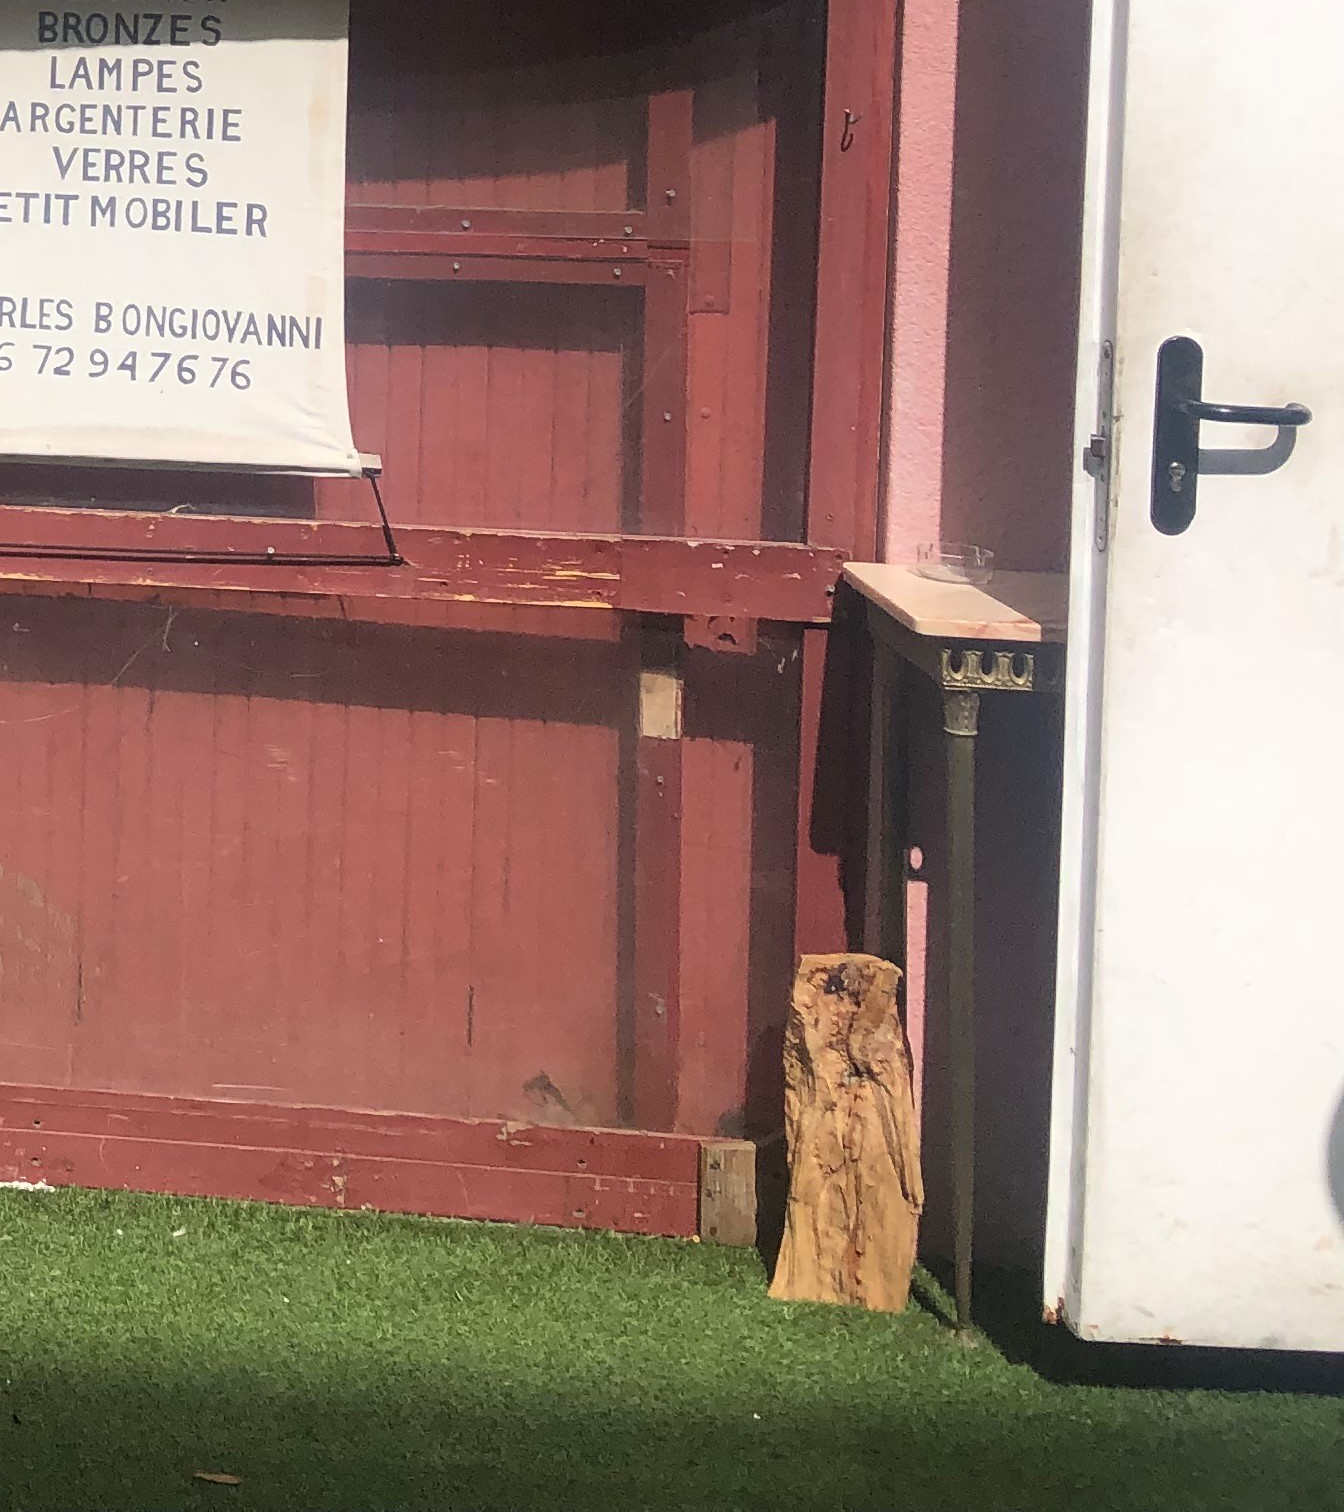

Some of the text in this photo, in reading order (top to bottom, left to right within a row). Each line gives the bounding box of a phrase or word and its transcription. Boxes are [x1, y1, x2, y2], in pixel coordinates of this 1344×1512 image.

[38, 10, 223, 47] BRONZES
[49, 56, 204, 94] LAMPES
[0, 101, 243, 142] ARGENTERIE
[52, 146, 210, 188] VERRES
[90, 195, 269, 238] MOBILER
[94, 302, 323, 350] BONGIOVANNI
